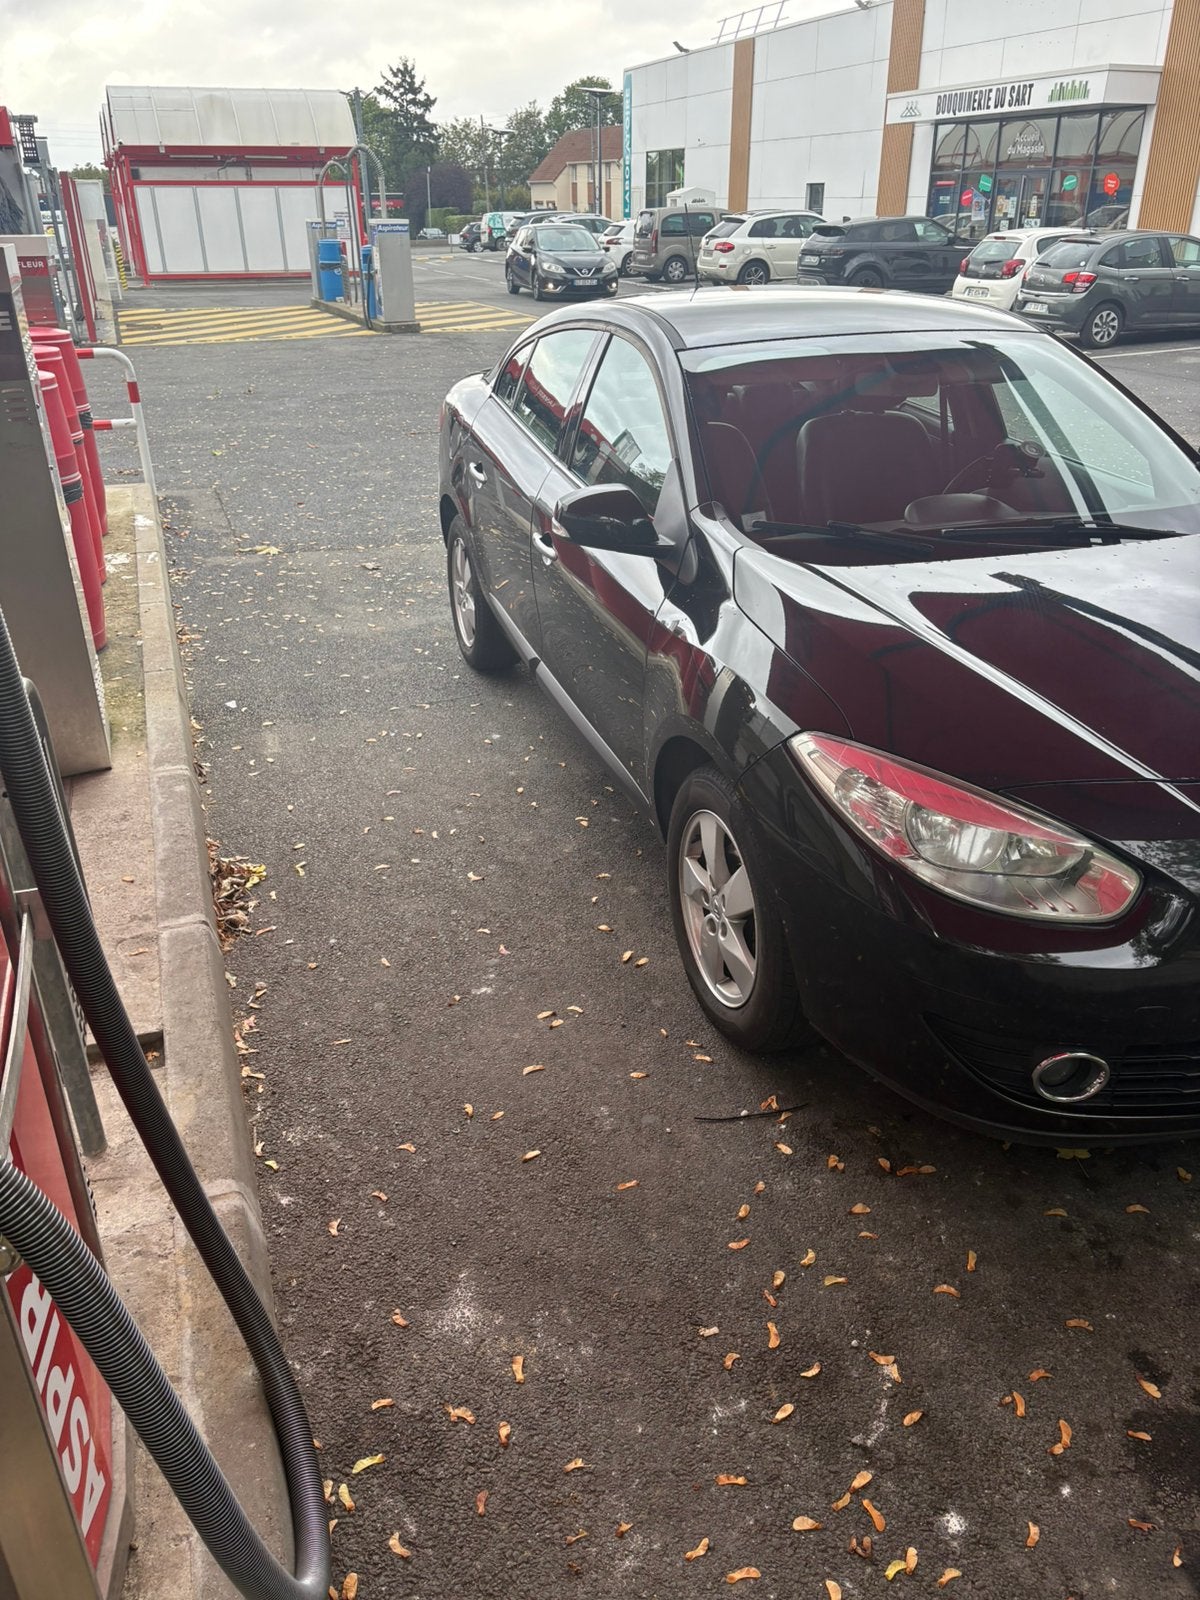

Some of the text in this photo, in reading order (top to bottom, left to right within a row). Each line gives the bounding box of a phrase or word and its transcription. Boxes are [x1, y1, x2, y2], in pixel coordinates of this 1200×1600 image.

[936, 83, 1034, 116] BOUQUINERIE DU SART
[1014, 131, 1040, 143] Accueil
[1007, 142, 1045, 157] du Magasin
[377, 224, 409, 233] Aspirateur
[5, 1271, 106, 1538] ASPIR
